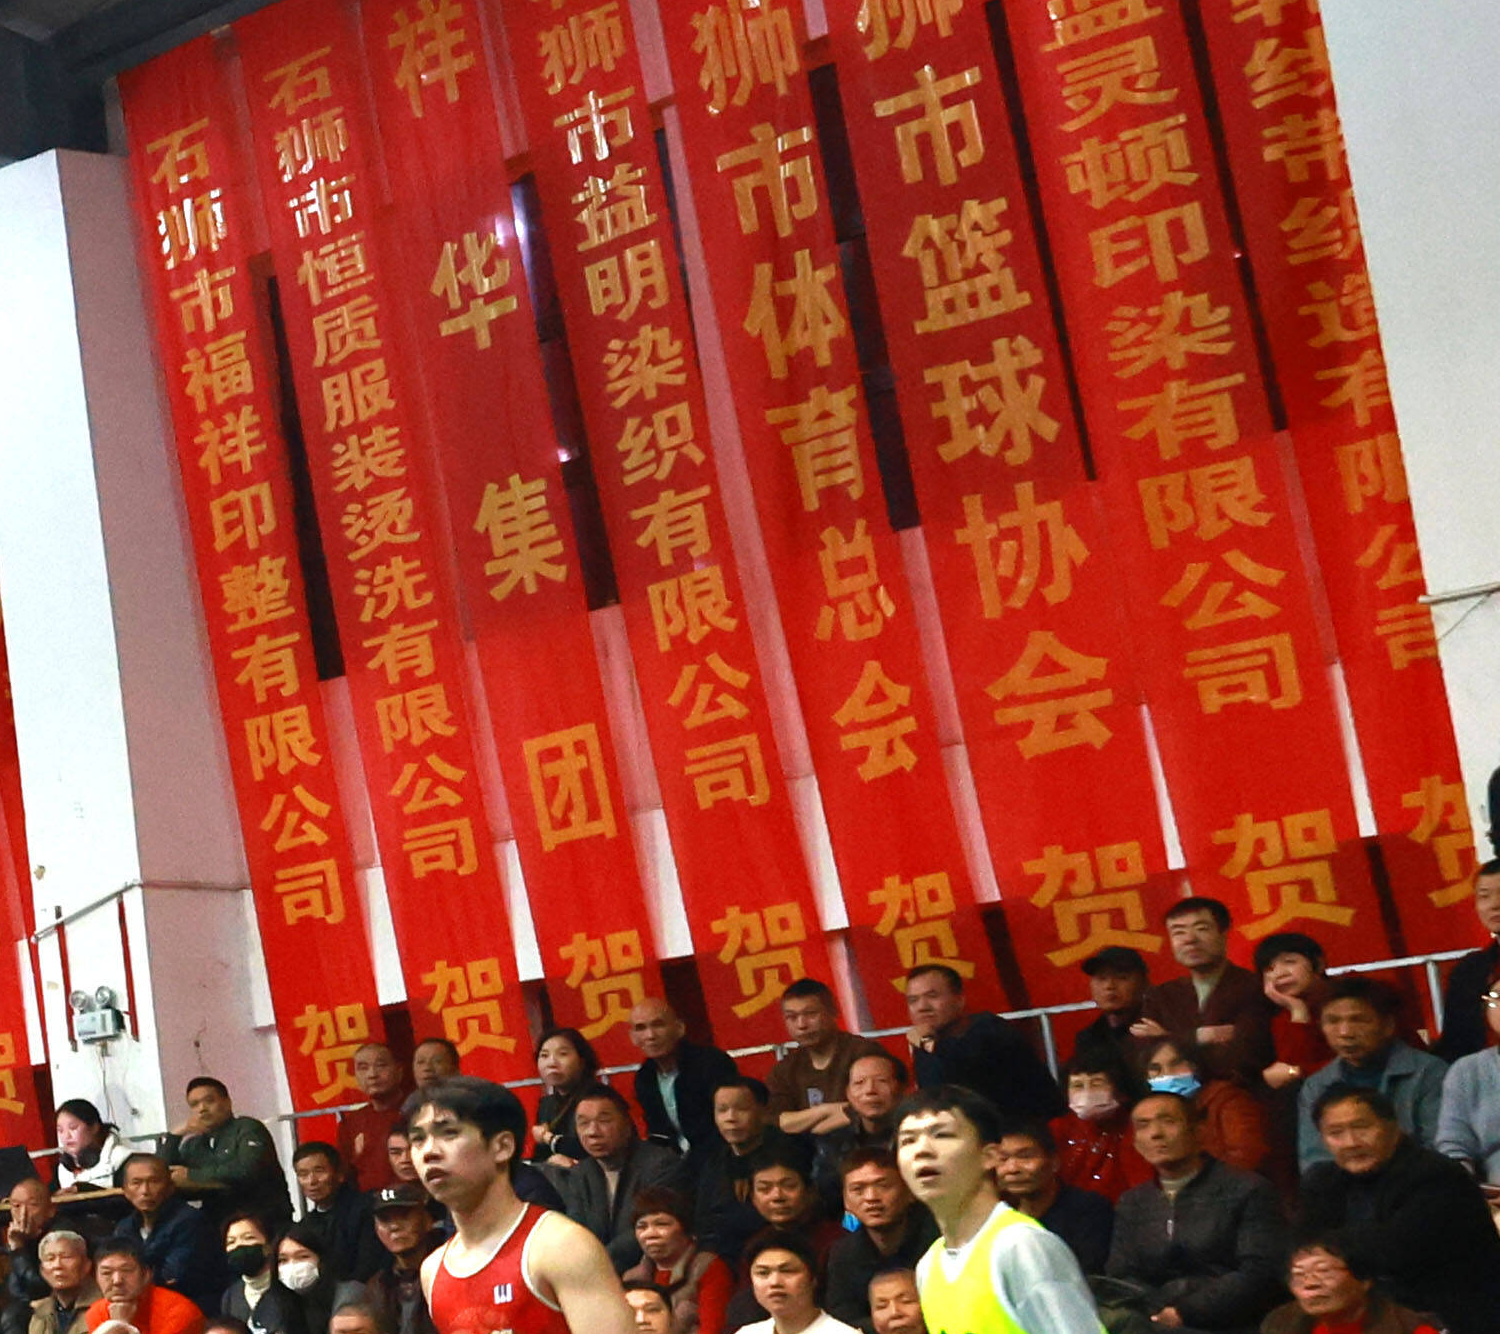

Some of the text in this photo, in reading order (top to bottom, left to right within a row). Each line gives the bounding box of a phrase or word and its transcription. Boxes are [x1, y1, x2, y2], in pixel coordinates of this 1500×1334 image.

[146, 117, 366, 1104] 石狮市福祥印整有限公司 贺
[868, 871, 974, 993] 贺
[1023, 841, 1163, 968] 贺
[1214, 809, 1356, 940] 贺
[420, 956, 517, 1059] 贺
[560, 928, 656, 1039] 贺
[711, 899, 806, 1019] 贺
